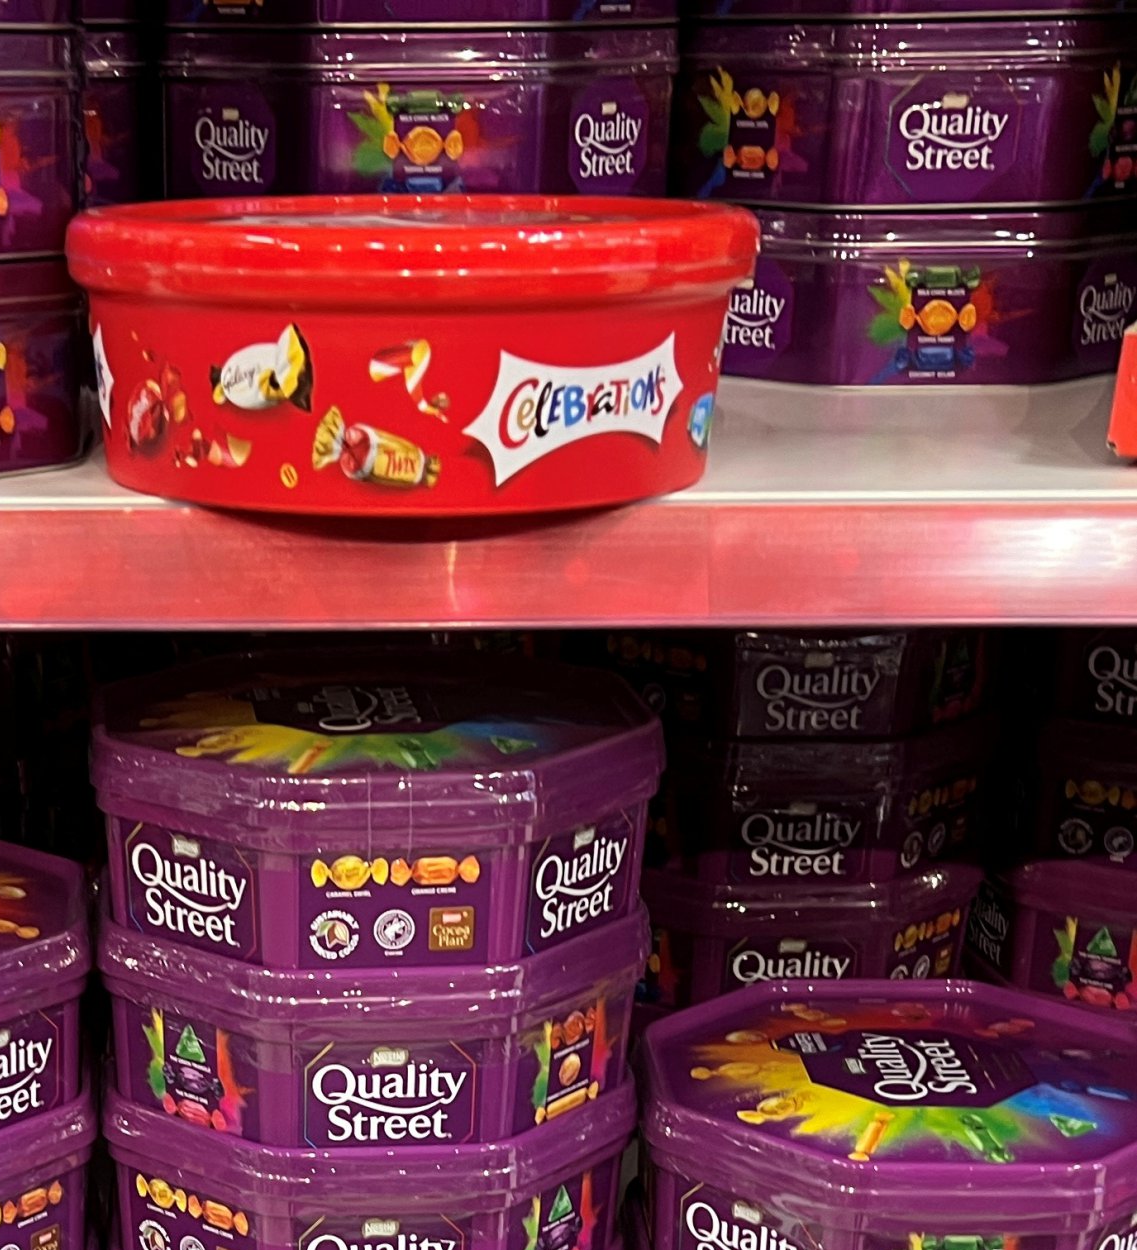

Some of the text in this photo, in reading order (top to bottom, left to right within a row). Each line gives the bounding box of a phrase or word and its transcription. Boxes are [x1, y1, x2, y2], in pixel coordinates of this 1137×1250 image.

[194, 113, 269, 160] Quality
[574, 111, 641, 156] Quality
[899, 104, 1008, 149] Quality
[727, 288, 785, 322] uality
[724, 323, 775, 350] treet
[757, 663, 880, 709] Quality
[741, 813, 860, 853] Quality
[131, 842, 246, 914] Quality
[535, 836, 627, 897] Quality
[144, 888, 241, 949] Street
[540, 883, 615, 940] Street
[732, 951, 850, 985] Quality
[312, 1062, 466, 1114] Quality
[859, 1033, 930, 1101] Quality
[327, 1105, 453, 1141] Street
